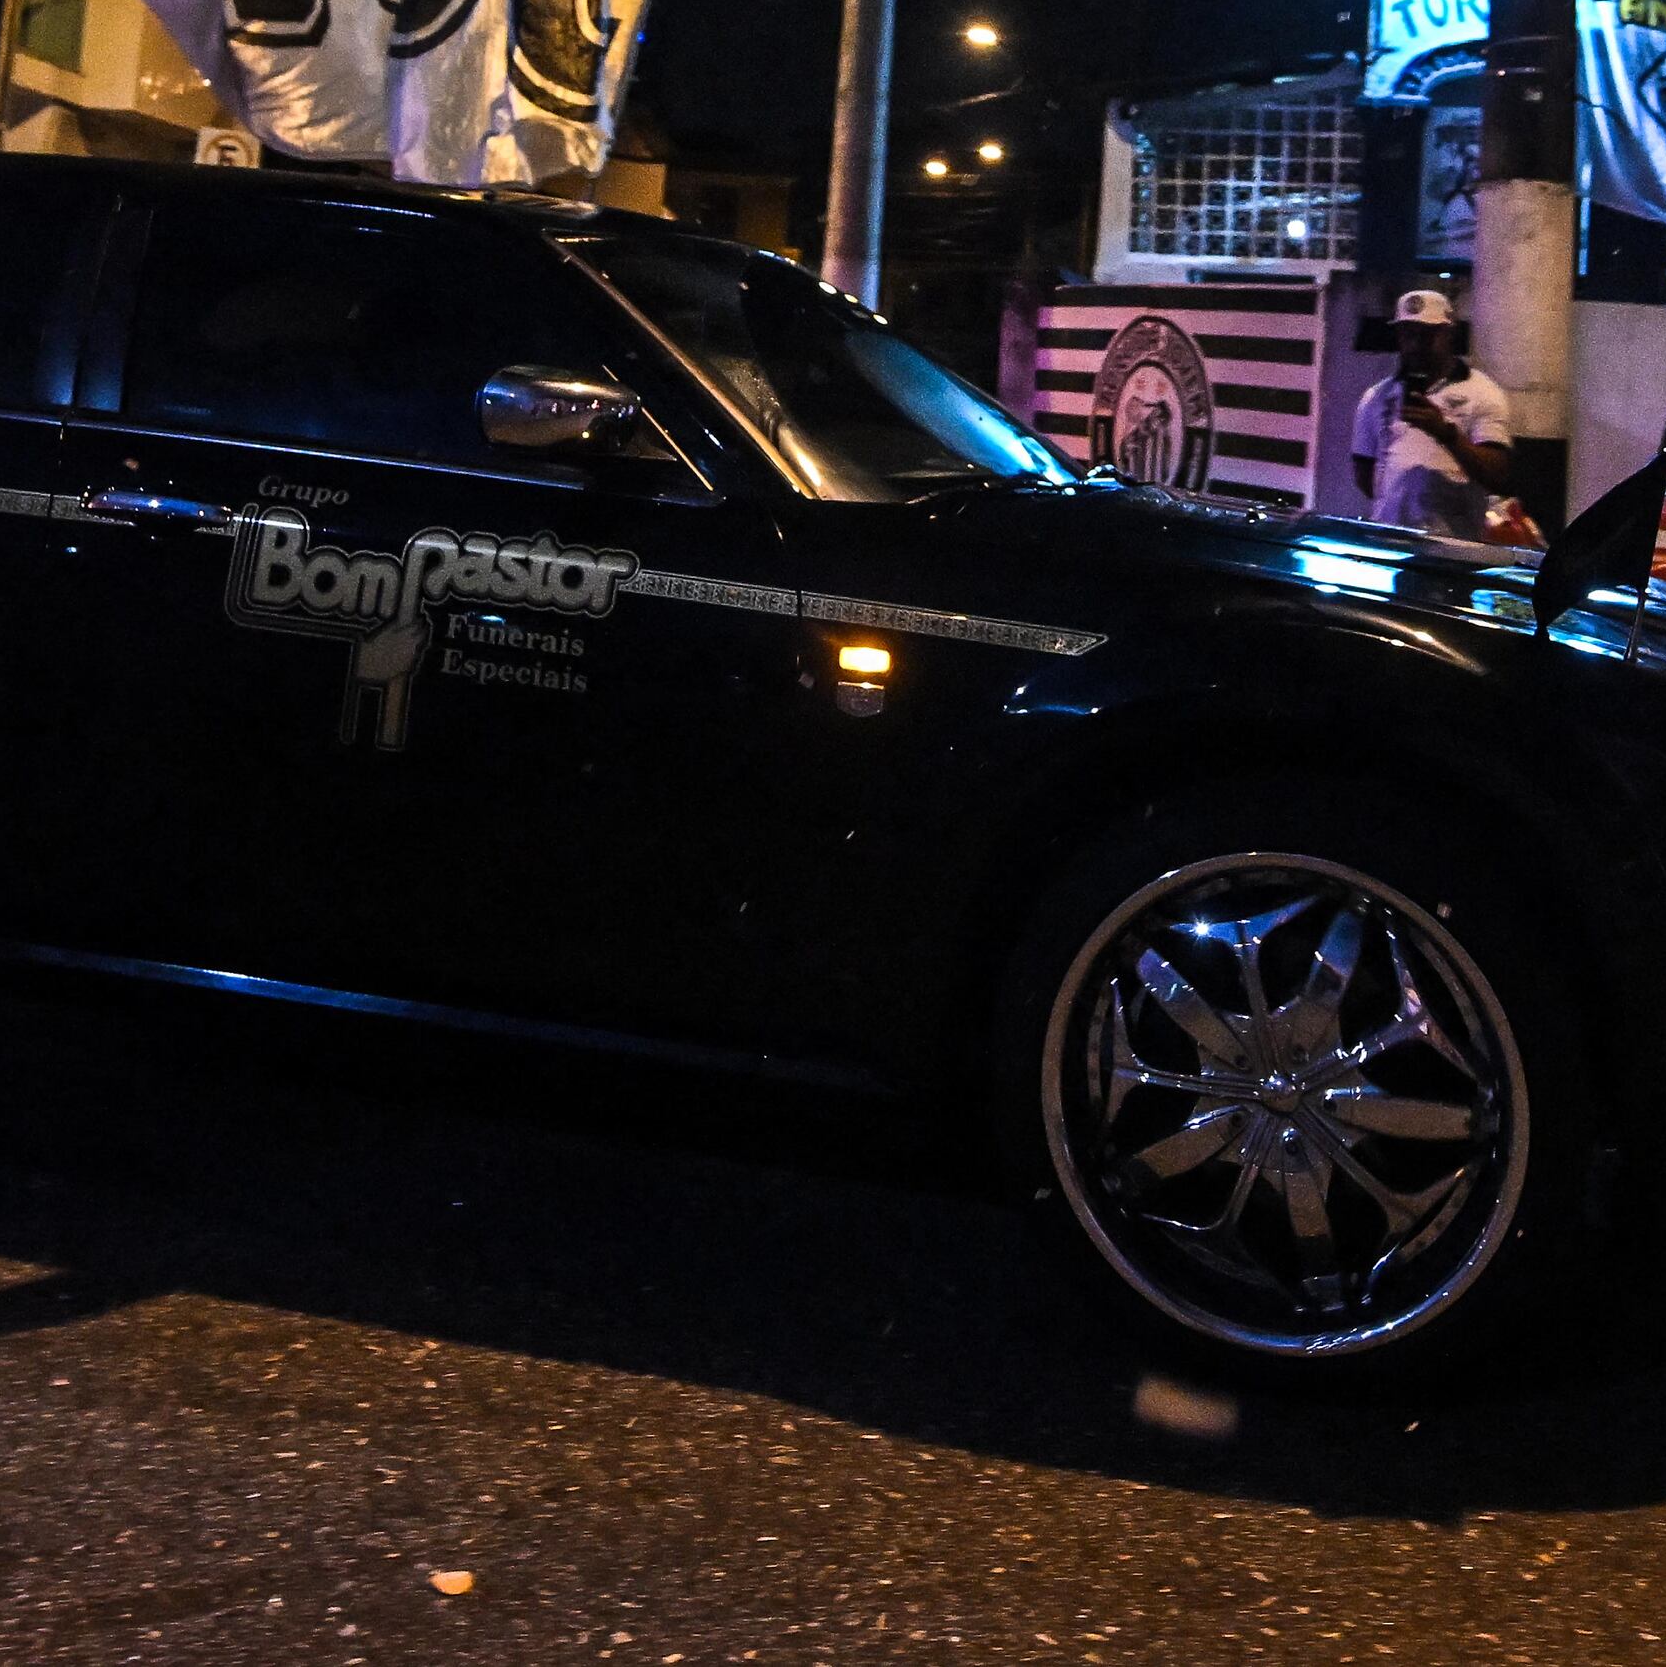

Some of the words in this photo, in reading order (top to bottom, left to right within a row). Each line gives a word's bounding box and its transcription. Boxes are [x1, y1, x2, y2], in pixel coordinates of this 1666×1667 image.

[257, 474, 351, 509] Grupo
[247, 505, 403, 623] Bom
[446, 611, 586, 657] Funerais
[440, 647, 590, 695] Especiais
